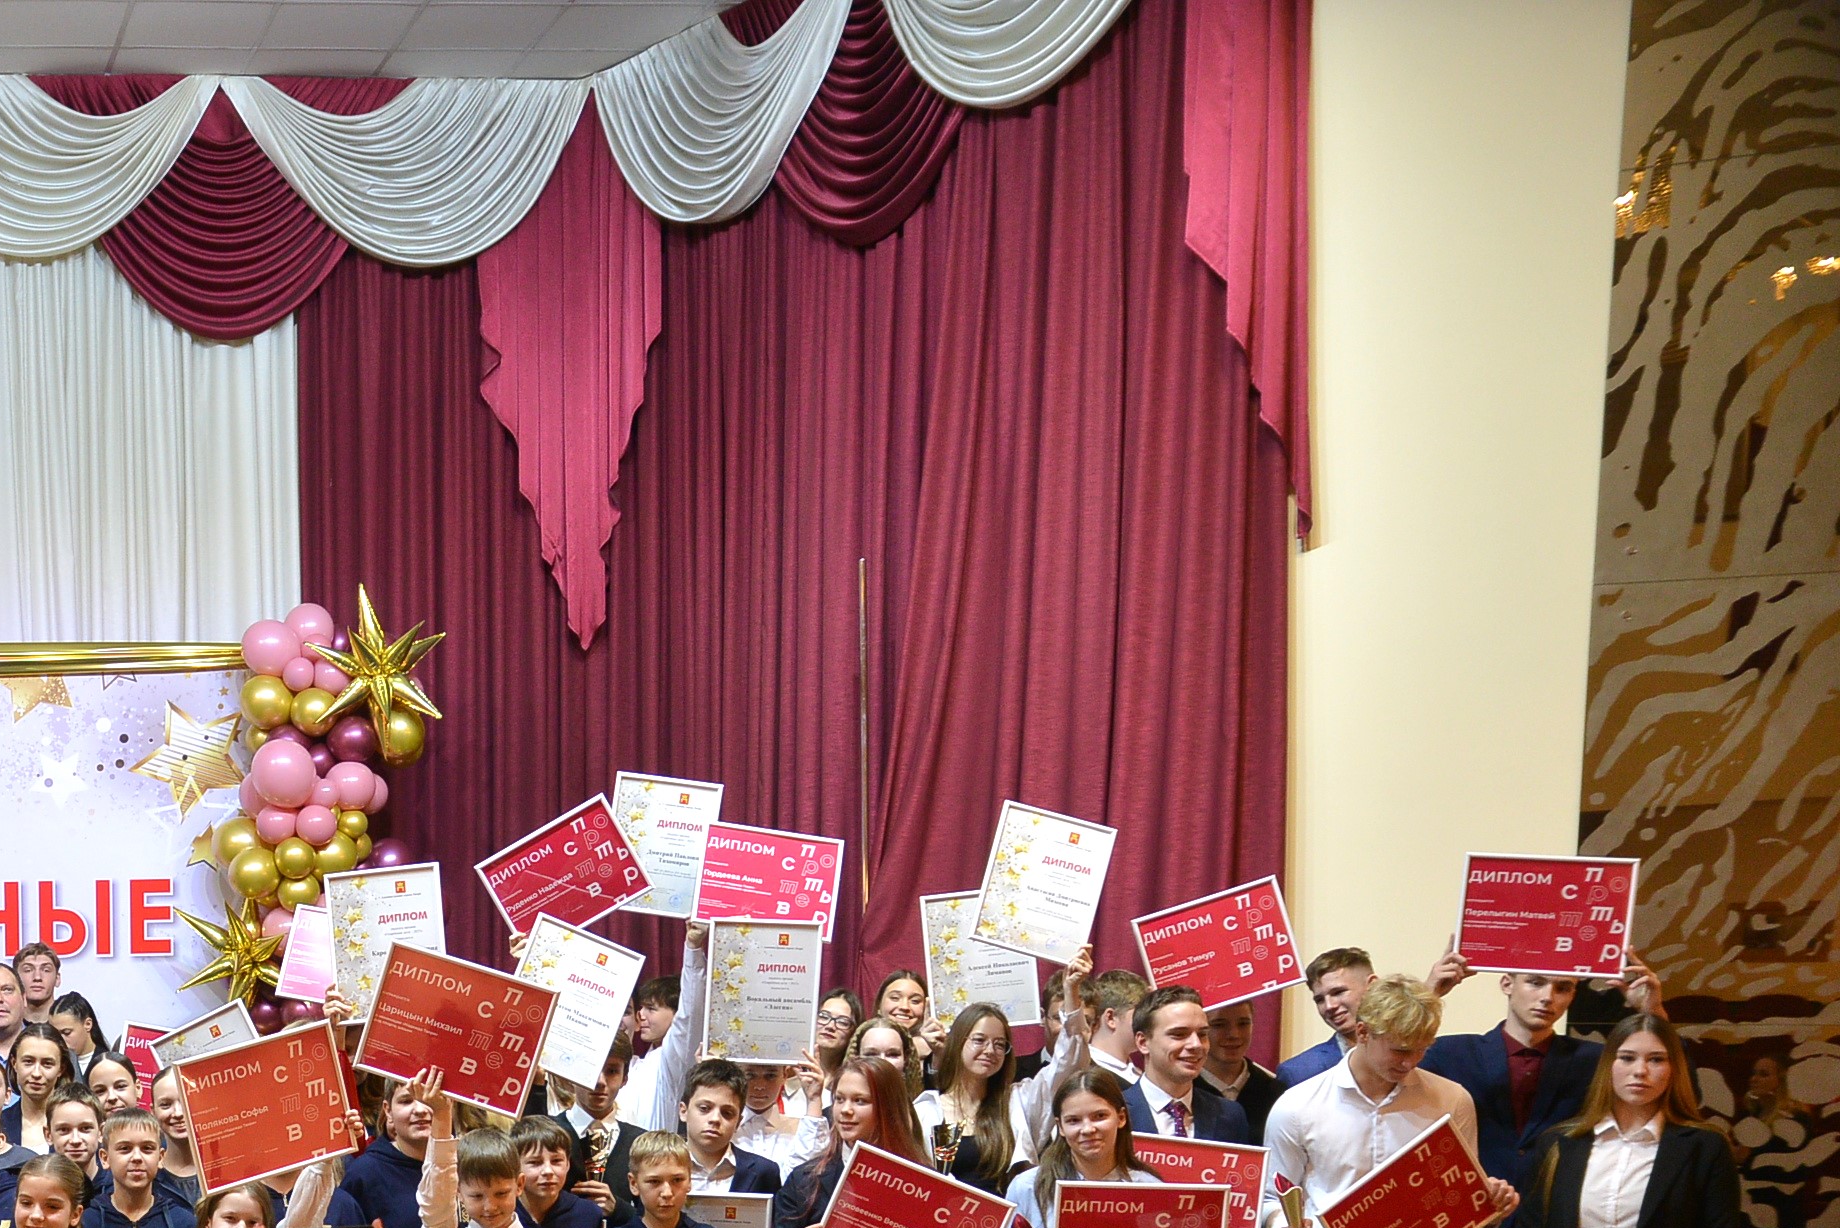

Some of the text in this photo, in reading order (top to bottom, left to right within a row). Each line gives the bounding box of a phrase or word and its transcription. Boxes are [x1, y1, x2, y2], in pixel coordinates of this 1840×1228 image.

[657, 820, 703, 832] ДИПЛОМ
[708, 836, 775, 856] ДИПЛОМ
[490, 844, 553, 888] ДИПЛОМ
[1042, 856, 1092, 875] ДИПЛОМ
[1468, 869, 1553, 885] ДИПЛОМ
[506, 893, 538, 913] Руденко
[378, 911, 428, 925] ДИПЛОМ
[1143, 913, 1213, 947] ДИПЛОМ
[757, 963, 807, 974] ДИПЛОМ
[1152, 959, 1188, 975] Русанов
[1187, 951, 1216, 964] Тимур
[389, 960, 473, 997] ДИПЛОМ
[567, 973, 615, 999] ДИПЛОМ
[378, 1002, 463, 1035] Царицын Михаил
[186, 1060, 261, 1095] ДИПЛОМ
[195, 1105, 269, 1132] Полякова Софья
[1135, 1150, 1193, 1168] ПЛОМ
[851, 1162, 931, 1202] ДИПЛОМ
[837, 1199, 883, 1222] Суховеенко
[1062, 1200, 1144, 1214] ДИПЛОМ
